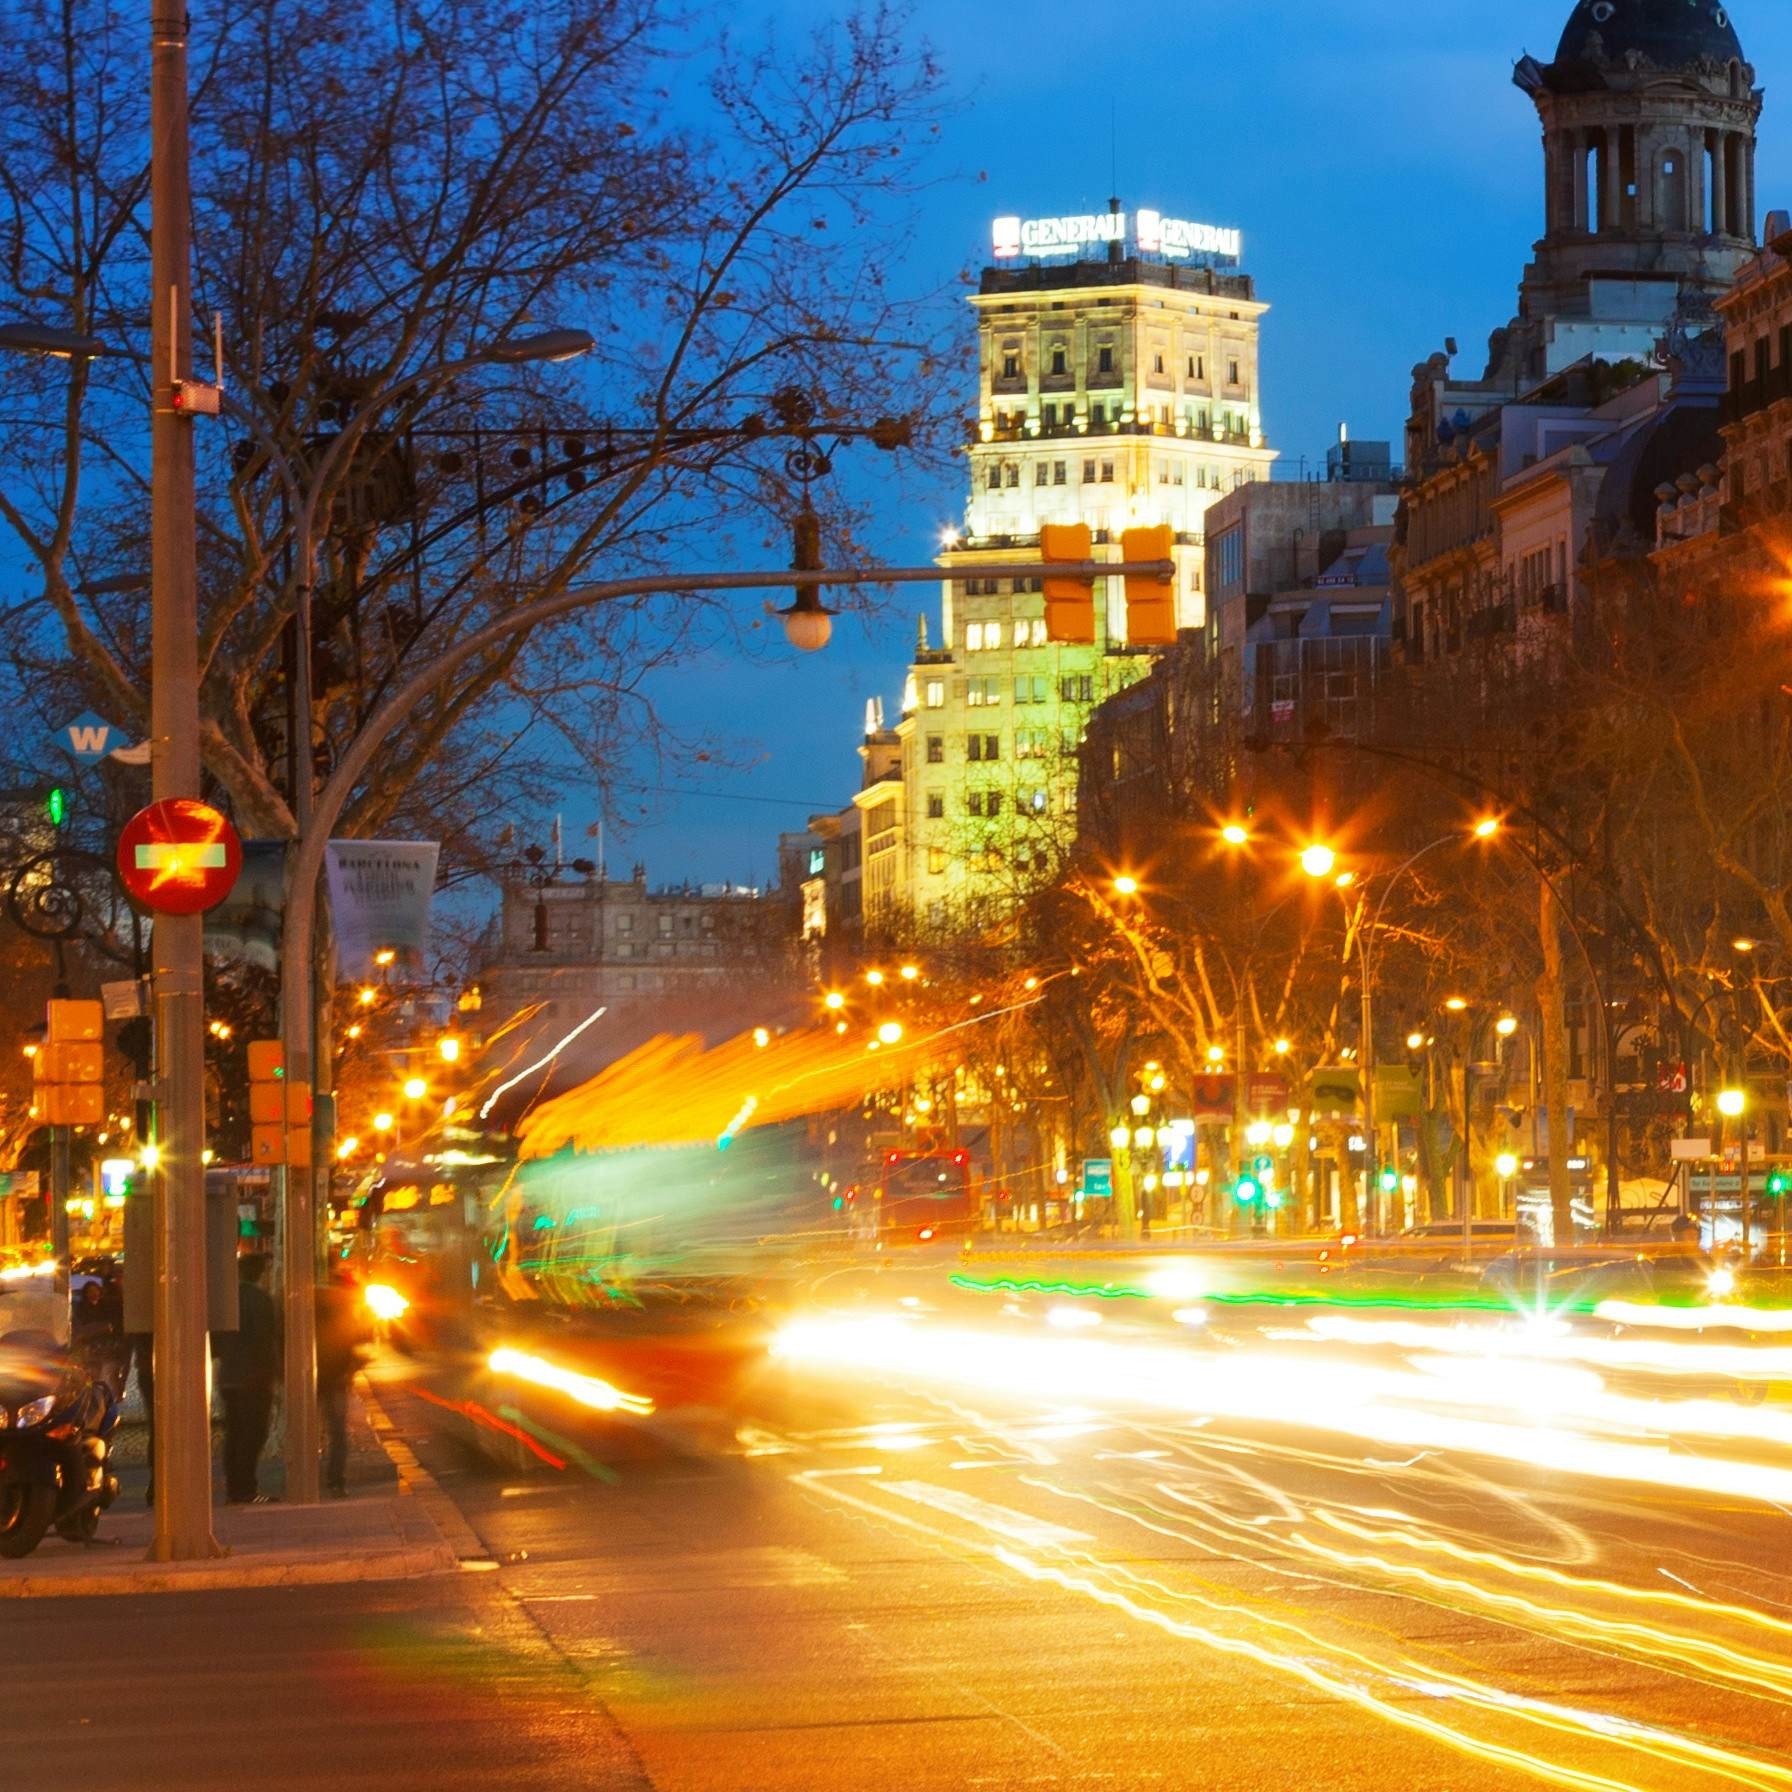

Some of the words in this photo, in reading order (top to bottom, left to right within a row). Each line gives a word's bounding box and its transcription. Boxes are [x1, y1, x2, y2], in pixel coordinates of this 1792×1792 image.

[1021, 213, 1125, 245] GENERALI
[1159, 218, 1240, 256] GENERALI
[69, 726, 109, 753] W
